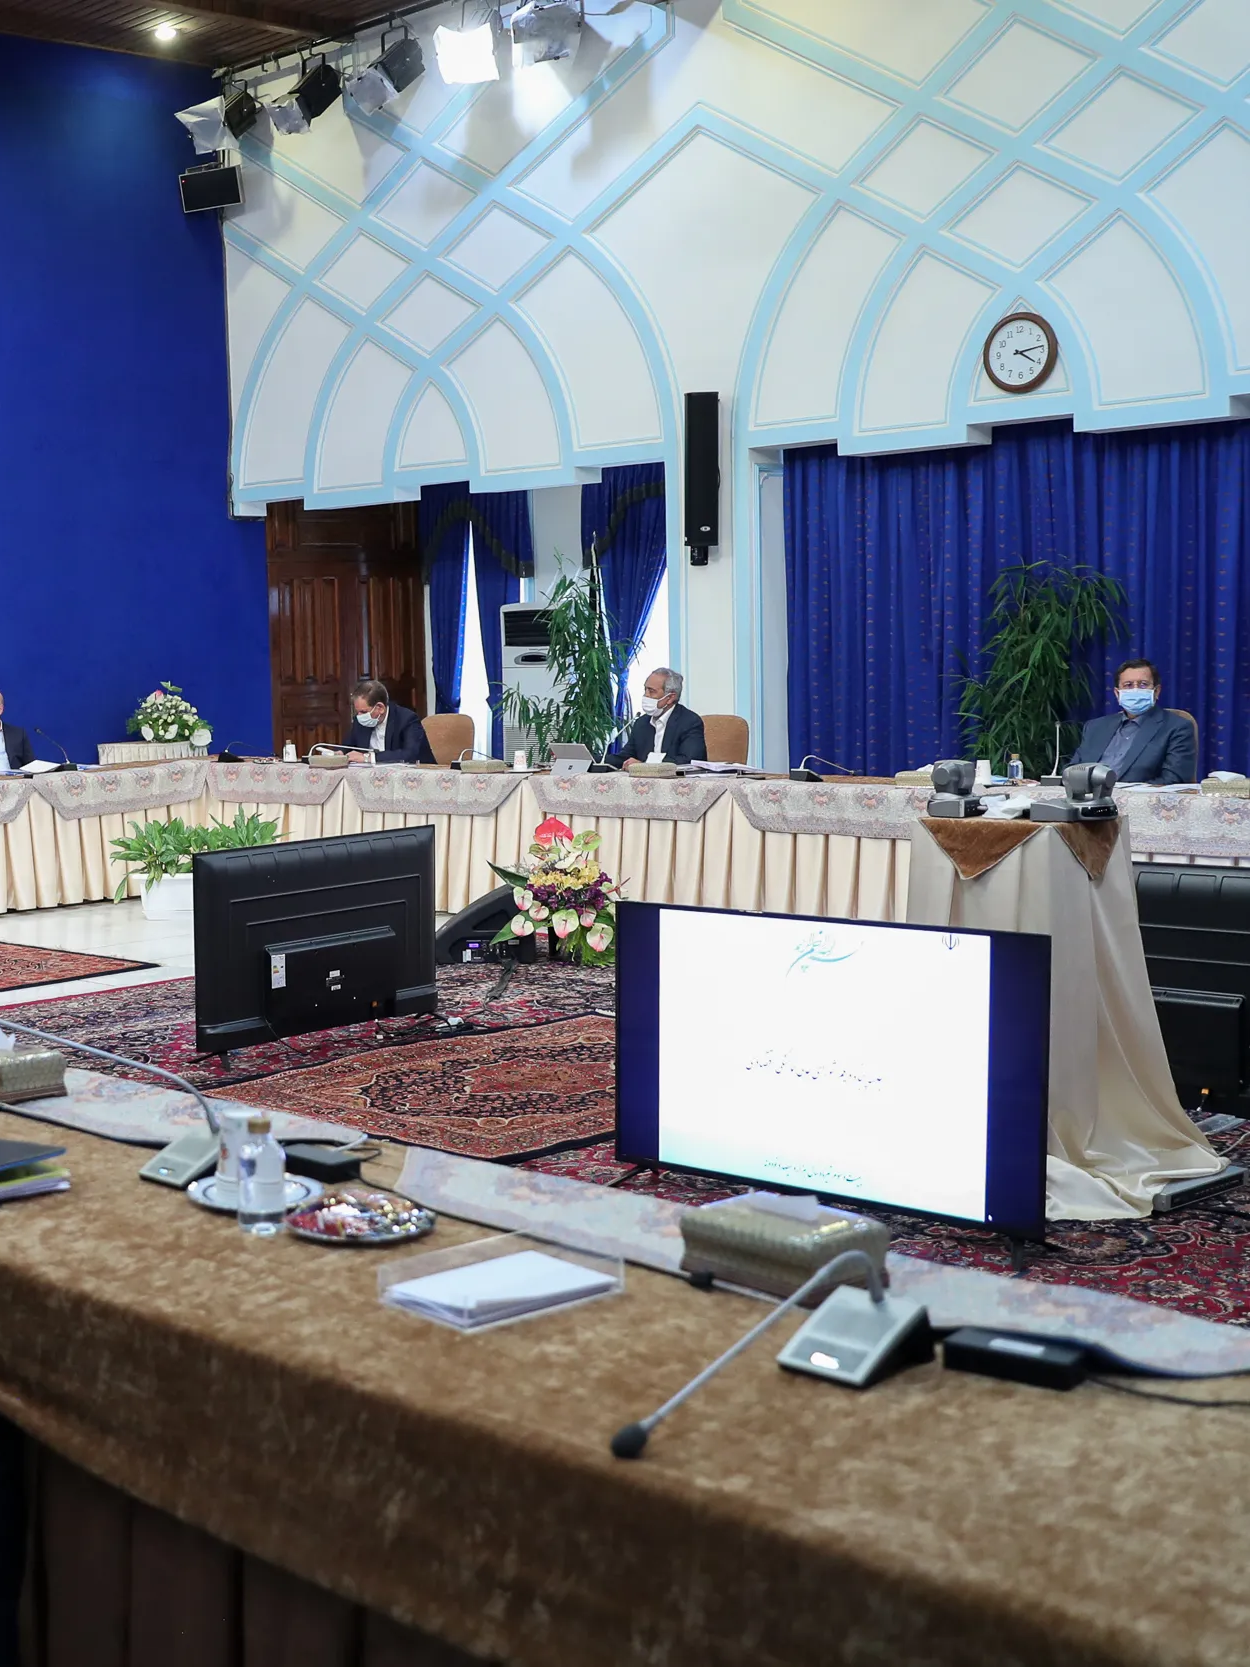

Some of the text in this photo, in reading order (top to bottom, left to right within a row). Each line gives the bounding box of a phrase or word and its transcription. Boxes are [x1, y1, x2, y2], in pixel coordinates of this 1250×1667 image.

[1016, 325, 1024, 334] 12
[1007, 331, 1013, 339] 11
[1036, 334, 1041, 342] 2
[999, 340, 1006, 348] 10
[996, 352, 1001, 360] 9
[1000, 363, 1005, 371] 8
[1029, 367, 1034, 375] 5
[1008, 370, 1013, 378] 7
